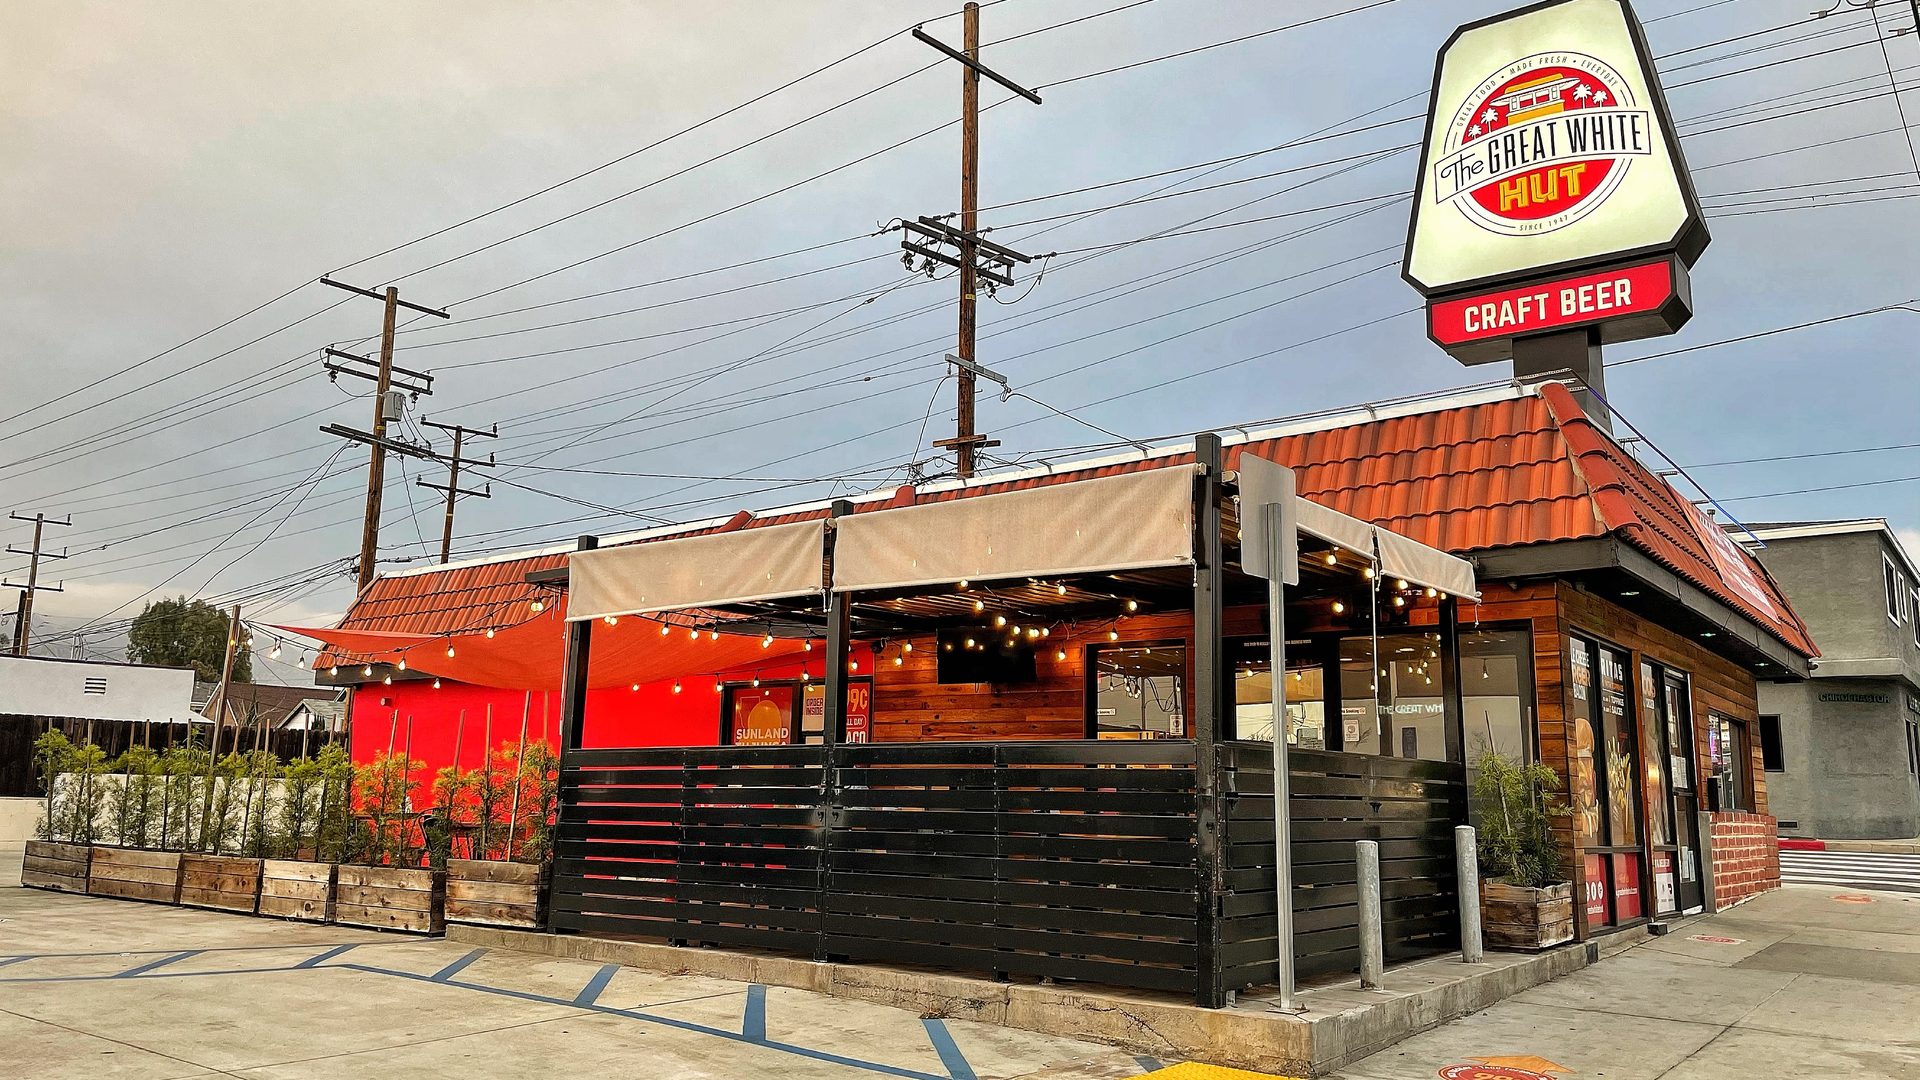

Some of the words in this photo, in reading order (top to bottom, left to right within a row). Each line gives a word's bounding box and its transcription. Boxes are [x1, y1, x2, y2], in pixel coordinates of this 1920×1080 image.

[1456, 102, 1475, 127] GREAT
[1475, 80, 1496, 100] FOOD
[1509, 60, 1533, 75] MADE
[1539, 56, 1568, 65] FRESH
[1580, 59, 1619, 87] EVERYDAY
[1440, 153, 1484, 192] The
[1488, 121, 1557, 175] GREAT
[1565, 114, 1642, 154] WHITE
[1499, 162, 1587, 212] HUT
[1519, 222, 1543, 231] SINCE
[1464, 293, 1550, 333] CRAFT
[1560, 278, 1632, 317] BEER
[806, 697, 823, 706] ORDER
[806, 706, 823, 716] INSIDE
[1395, 704, 1423, 714] GREAT
[736, 727, 789, 740] SUNLAND
[846, 730, 866, 744] ACO
